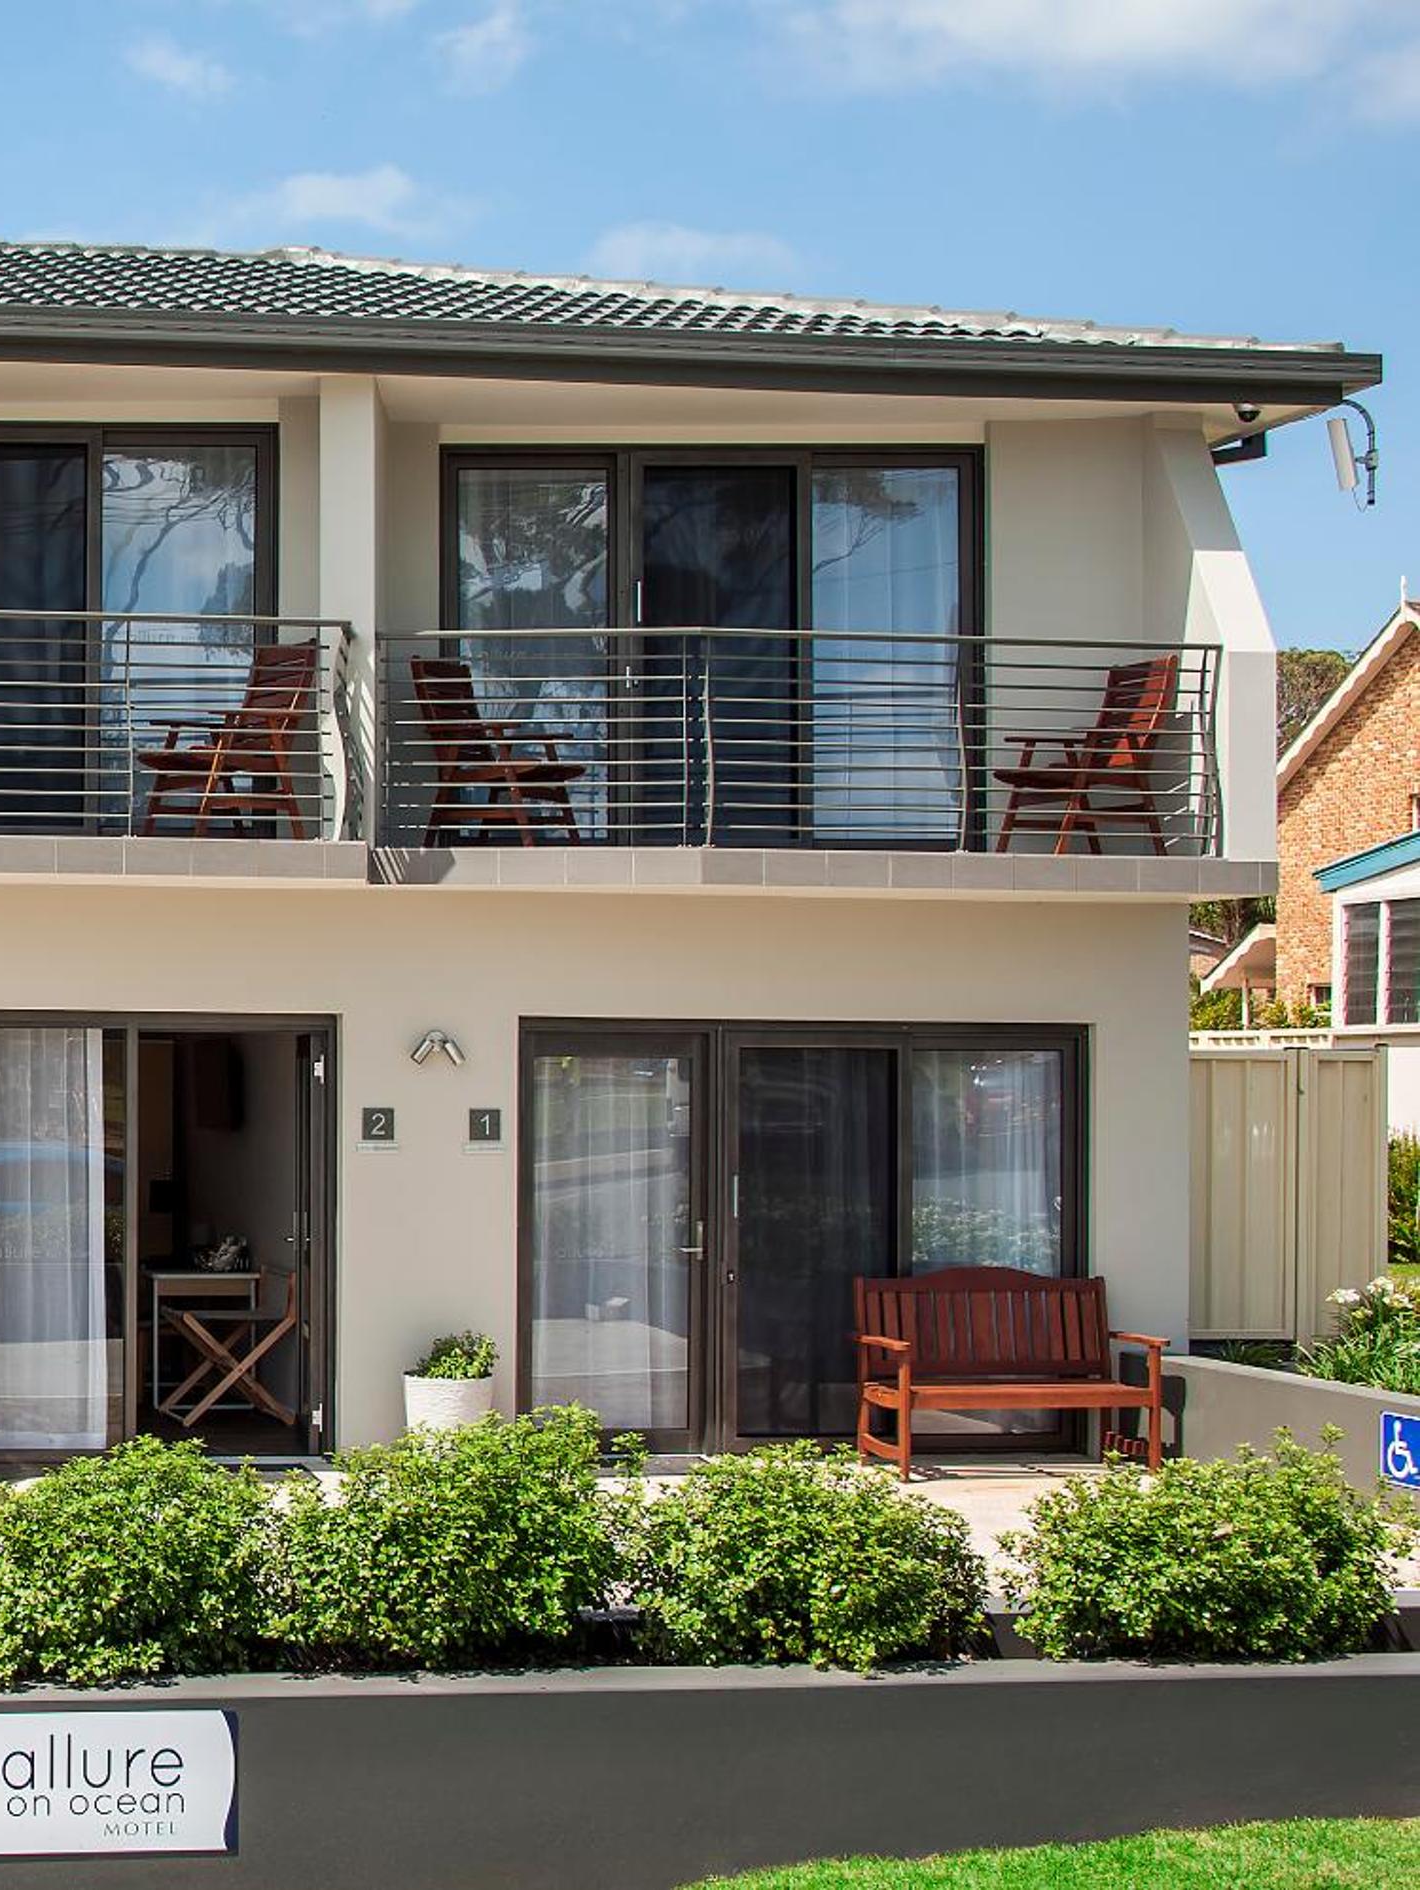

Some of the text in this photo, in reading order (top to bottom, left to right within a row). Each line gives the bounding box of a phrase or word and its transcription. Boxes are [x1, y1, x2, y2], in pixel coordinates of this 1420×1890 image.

[370, 1112, 386, 1136] 2
[480, 1113, 491, 1136] 1
[2, 1732, 184, 1791] allure
[6, 1792, 185, 1817] on ocean
[103, 1820, 176, 1837] MOTEL
